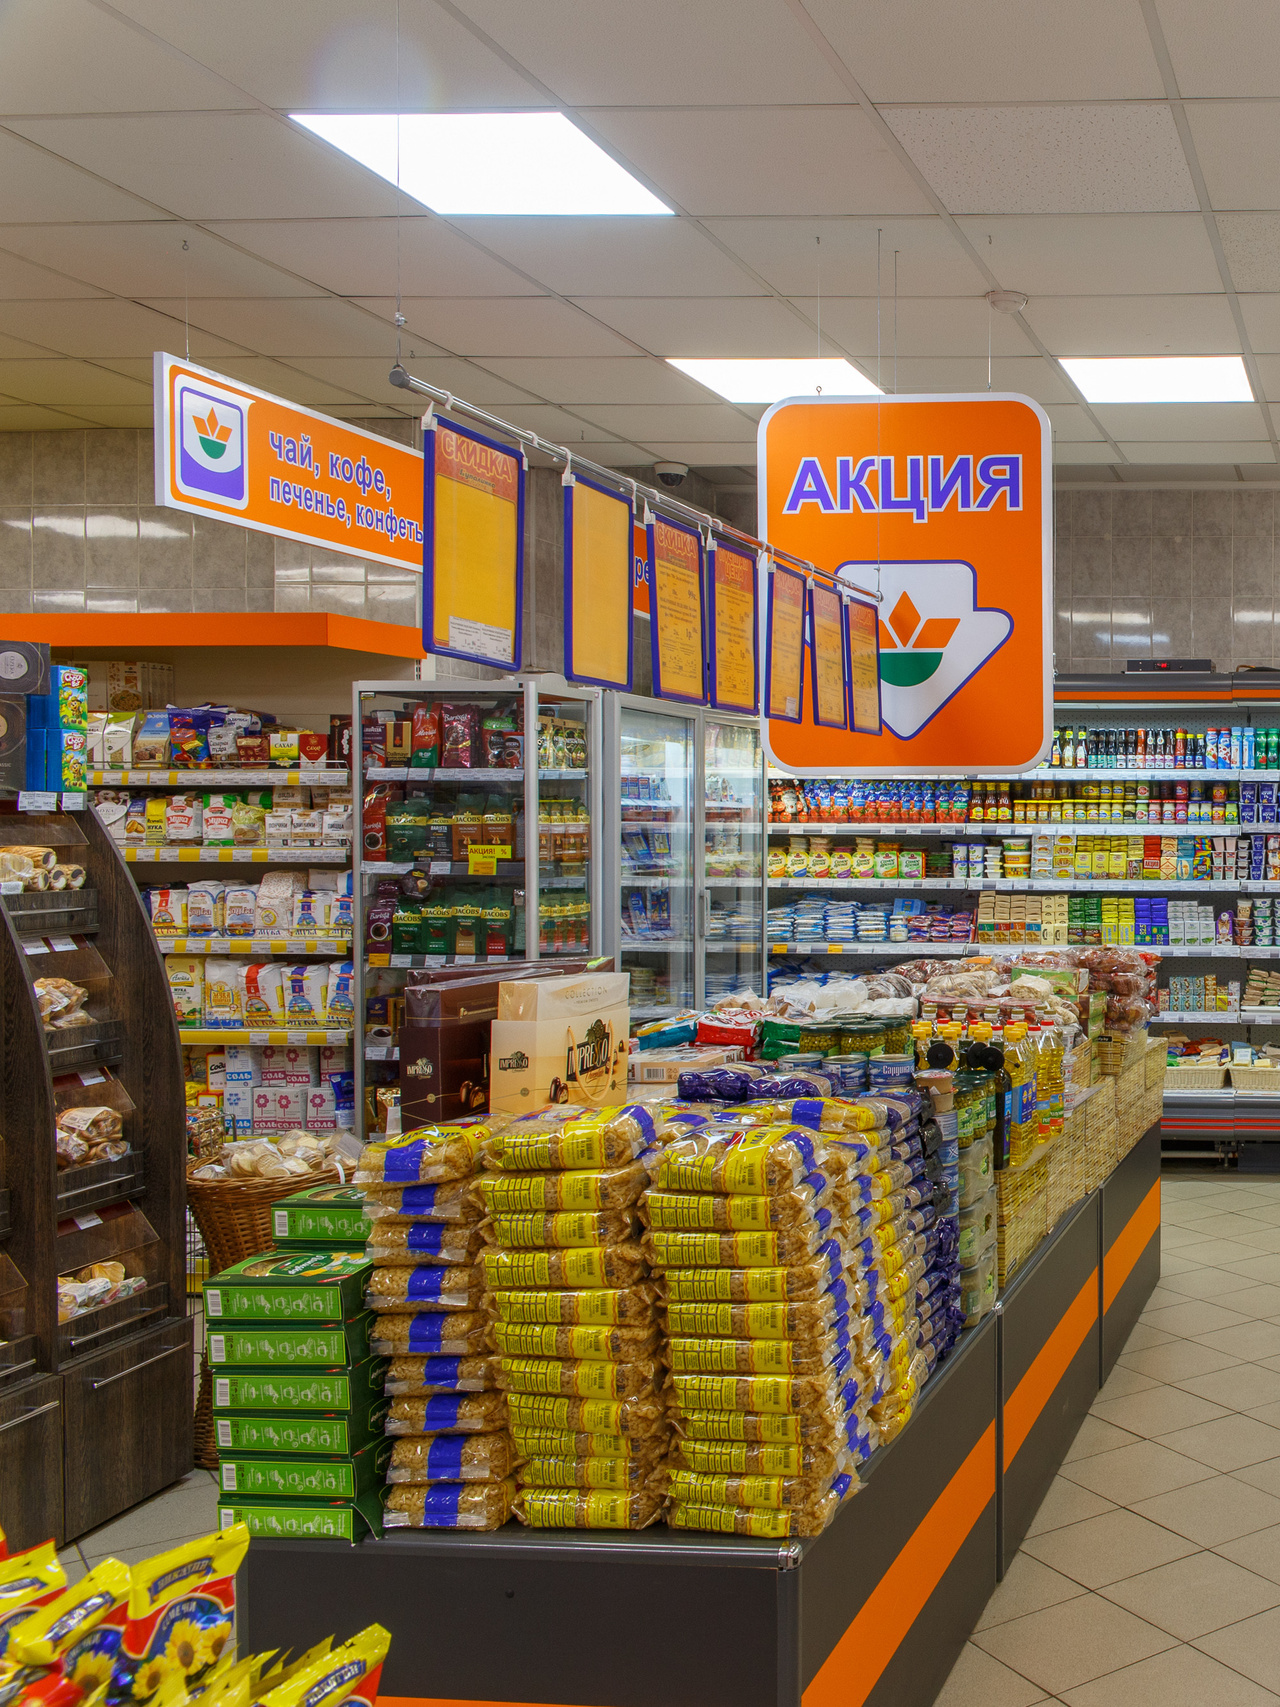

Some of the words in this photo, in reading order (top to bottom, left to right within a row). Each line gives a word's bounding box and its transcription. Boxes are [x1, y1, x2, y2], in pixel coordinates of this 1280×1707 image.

[440, 429, 512, 483] СКИДКА
[268, 428, 320, 473] чай,
[328, 449, 393, 503] кофе,
[783, 454, 1023, 523] АКЦИЯ
[268, 474, 350, 526] печенье,
[656, 523, 697, 559] СКИДКА
[468, 847, 496, 855] АКЦИЯ!
[425, 908, 451, 917] JACOBS
[454, 907, 480, 915] JACOBS
[483, 909, 509, 918] JACOBS
[395, 914, 422, 922] JACOBS
[258, 928, 282, 937] МУКА
[564, 987, 609, 1000] COLLECTION
[568, 1036, 610, 1079] IMPRESSO
[499, 1058, 529, 1070] IMPRESSO
[406, 1064, 433, 1076] IMPRESSO
[226, 1072, 252, 1081] СОЛЬ
[262, 1072, 286, 1081] СОЛЬ
[286, 1075, 310, 1084] СОЛЬ
[278, 1121, 301, 1130] СОЛЬ
[308, 1121, 336, 1129] СОЛЬ
